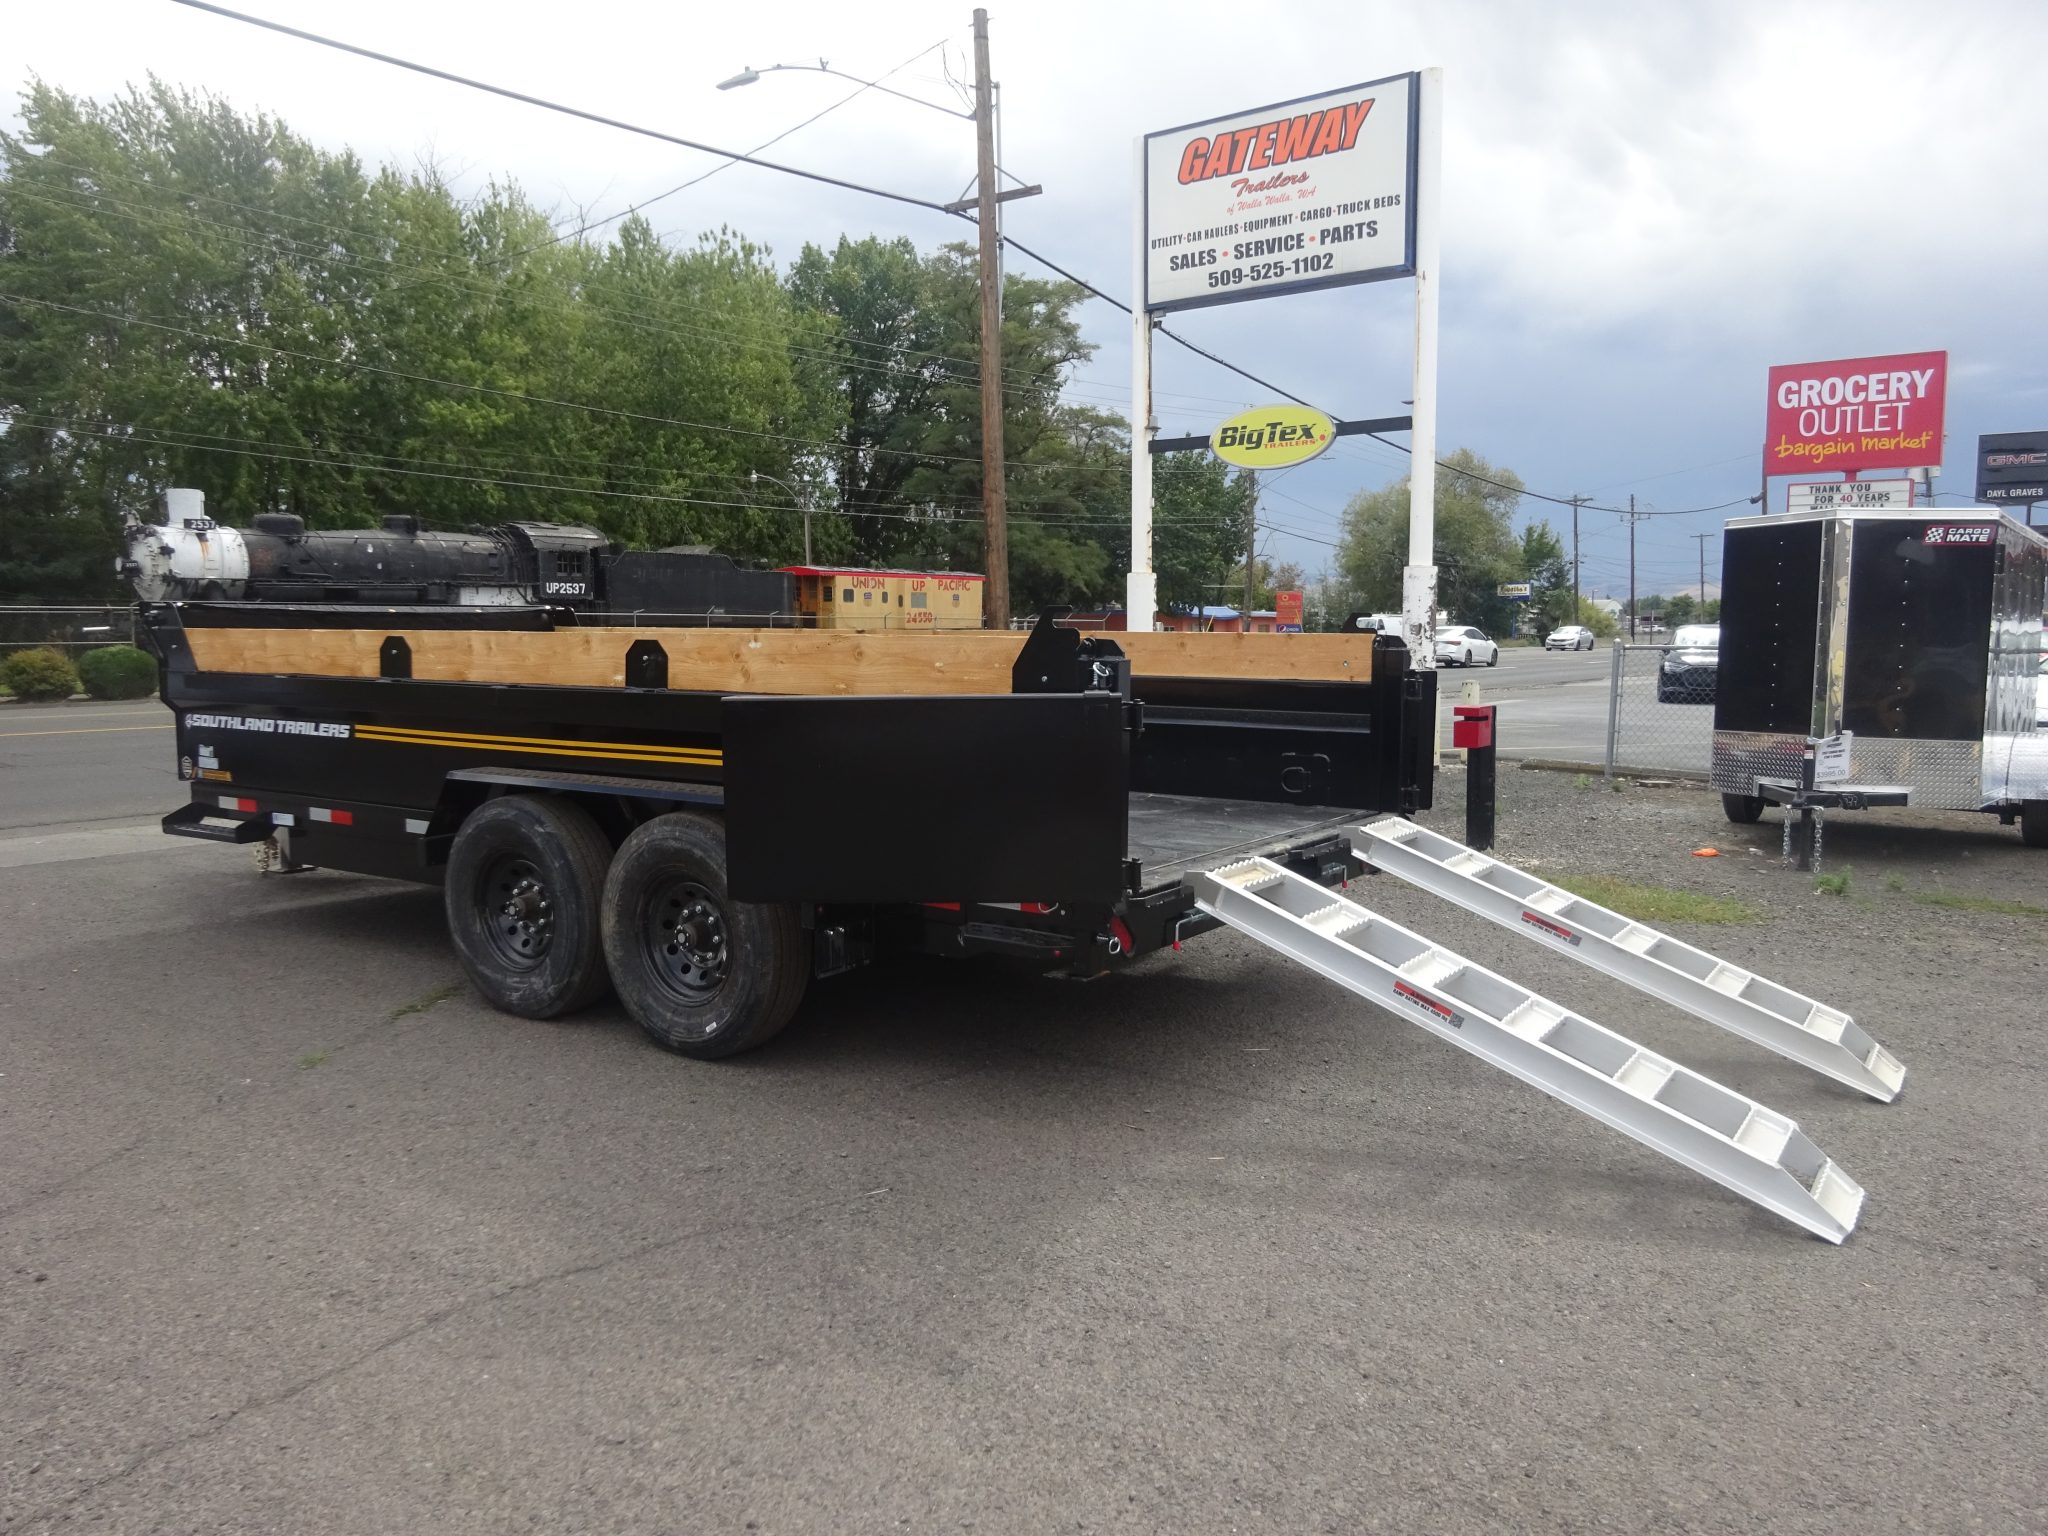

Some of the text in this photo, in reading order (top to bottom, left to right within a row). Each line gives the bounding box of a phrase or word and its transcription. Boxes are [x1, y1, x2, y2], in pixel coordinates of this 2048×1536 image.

[1178, 98, 1375, 185] GATEWAY
[1231, 171, 1310, 197] Trailers
[1237, 199, 1262, 211] Walla
[1297, 186, 1317, 199] WA
[1151, 194, 1400, 250] UTILITY CAR HAULERS EQUIPMENT CARGO TRUCK BEDS
[1169, 219, 1378, 271] SALES SERVICE PARTS
[1208, 252, 1334, 288] 509-525-1102
[1777, 369, 1935, 409] GROCERY
[1798, 401, 1911, 437] OUTLET
[1264, 439, 1316, 449] TRAILERS
[1774, 434, 1855, 464] bargain
[1986, 453, 2048, 466] GMC
[1809, 483, 1871, 494] THANK YOU
[1814, 492, 1890, 504] FOR 40 YEARS
[1986, 488, 2044, 498] DAYL GRAVES
[190, 520, 216, 529] 2537
[1946, 534, 1989, 542] MATE
[546, 582, 585, 594] UP2537
[851, 576, 971, 591] UNION UP PACIFIC
[192, 713, 350, 738] SOUTHLAND TRAILERS
